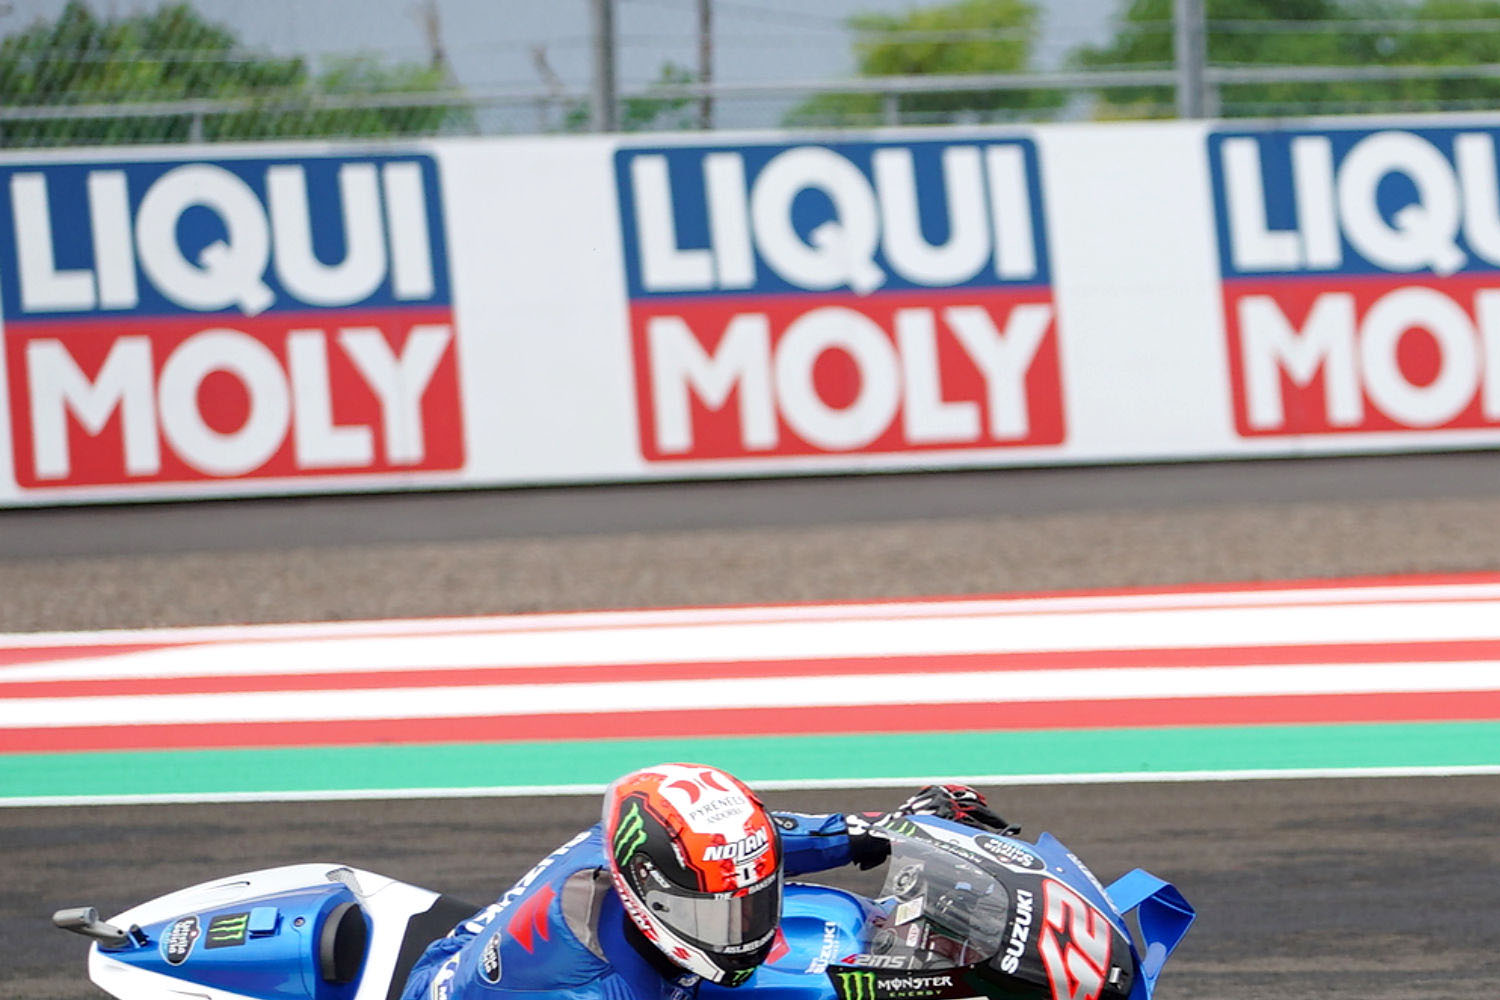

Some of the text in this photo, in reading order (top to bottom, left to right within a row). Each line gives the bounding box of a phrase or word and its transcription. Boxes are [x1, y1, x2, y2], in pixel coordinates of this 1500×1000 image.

[11, 160, 436, 315] LIQUI
[630, 145, 1037, 294] LIQUI
[26, 324, 454, 478] MOLY
[645, 305, 1054, 454] MOLY
[702, 827, 769, 862] NOLAN
[877, 975, 953, 991] MONSTER
[1001, 889, 1034, 975] SUZUKI
